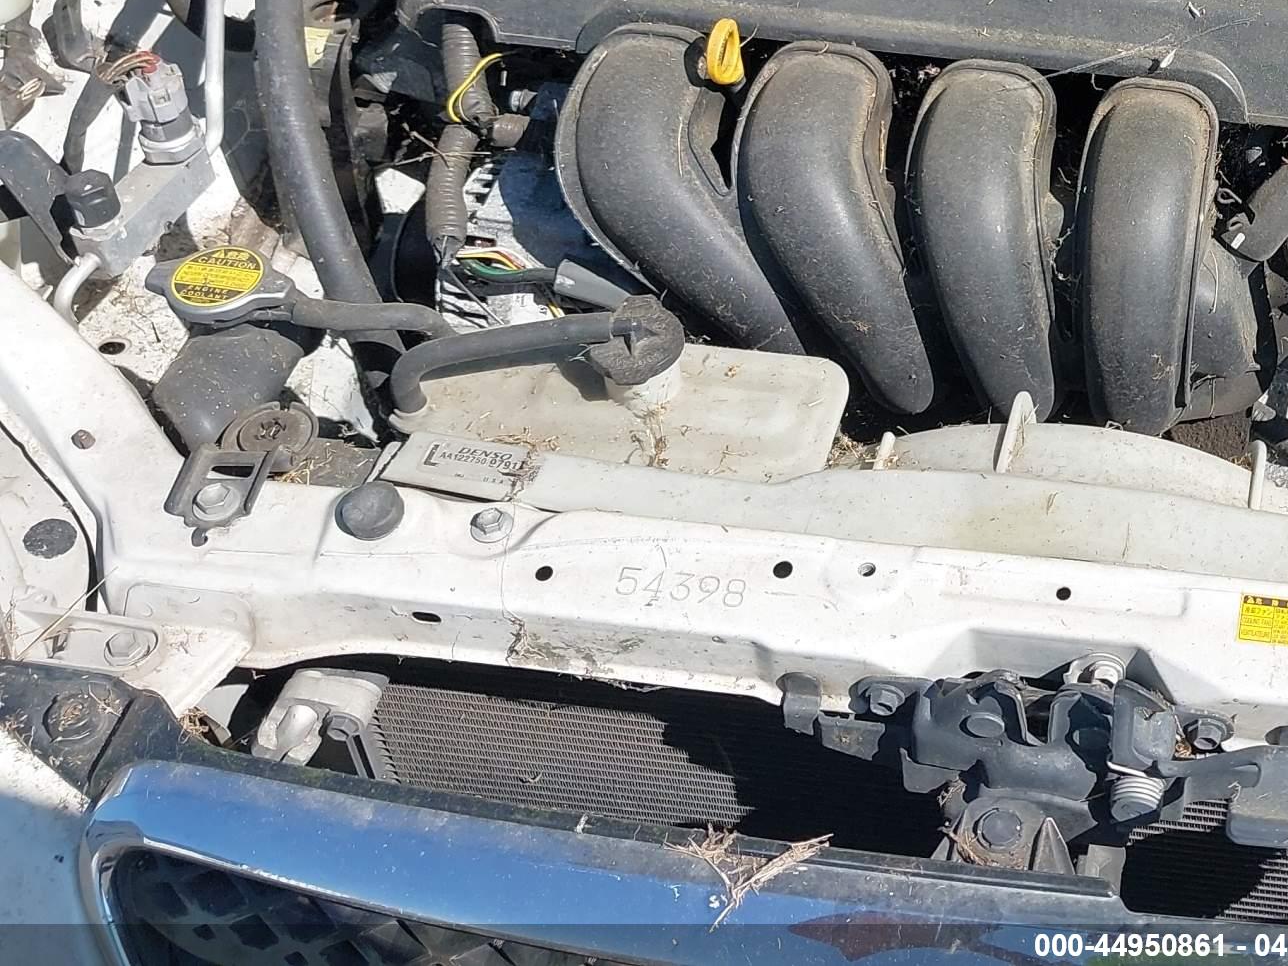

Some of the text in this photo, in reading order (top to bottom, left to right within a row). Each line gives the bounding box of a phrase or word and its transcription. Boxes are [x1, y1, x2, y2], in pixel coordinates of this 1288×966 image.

[198, 256, 257, 270] CAUTION
[180, 289, 229, 300] COOLANT
[187, 285, 230, 295] ENGINE
[458, 447, 513, 461] DENSO
[615, 566, 747, 608] 54398
